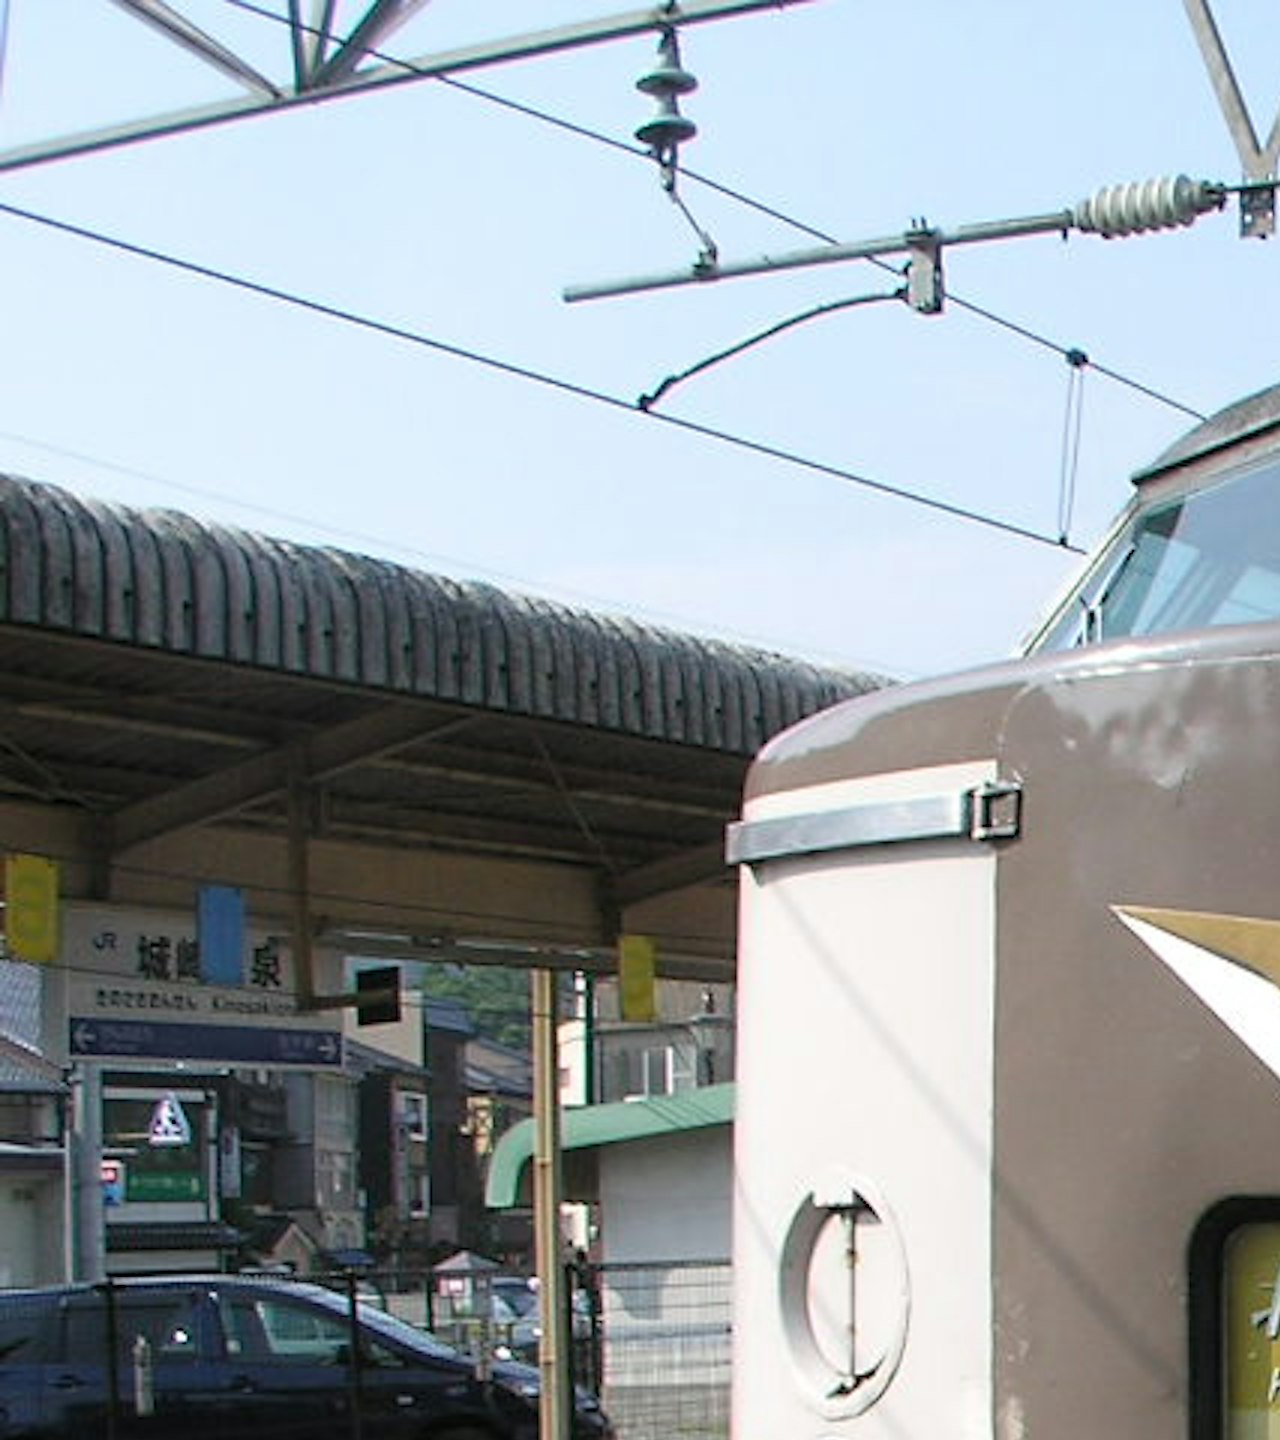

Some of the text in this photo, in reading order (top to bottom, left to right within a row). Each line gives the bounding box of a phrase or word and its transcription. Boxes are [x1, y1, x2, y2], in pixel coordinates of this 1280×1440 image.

[91, 932, 118, 951] JR
[136, 935, 281, 987] 城崎泉
